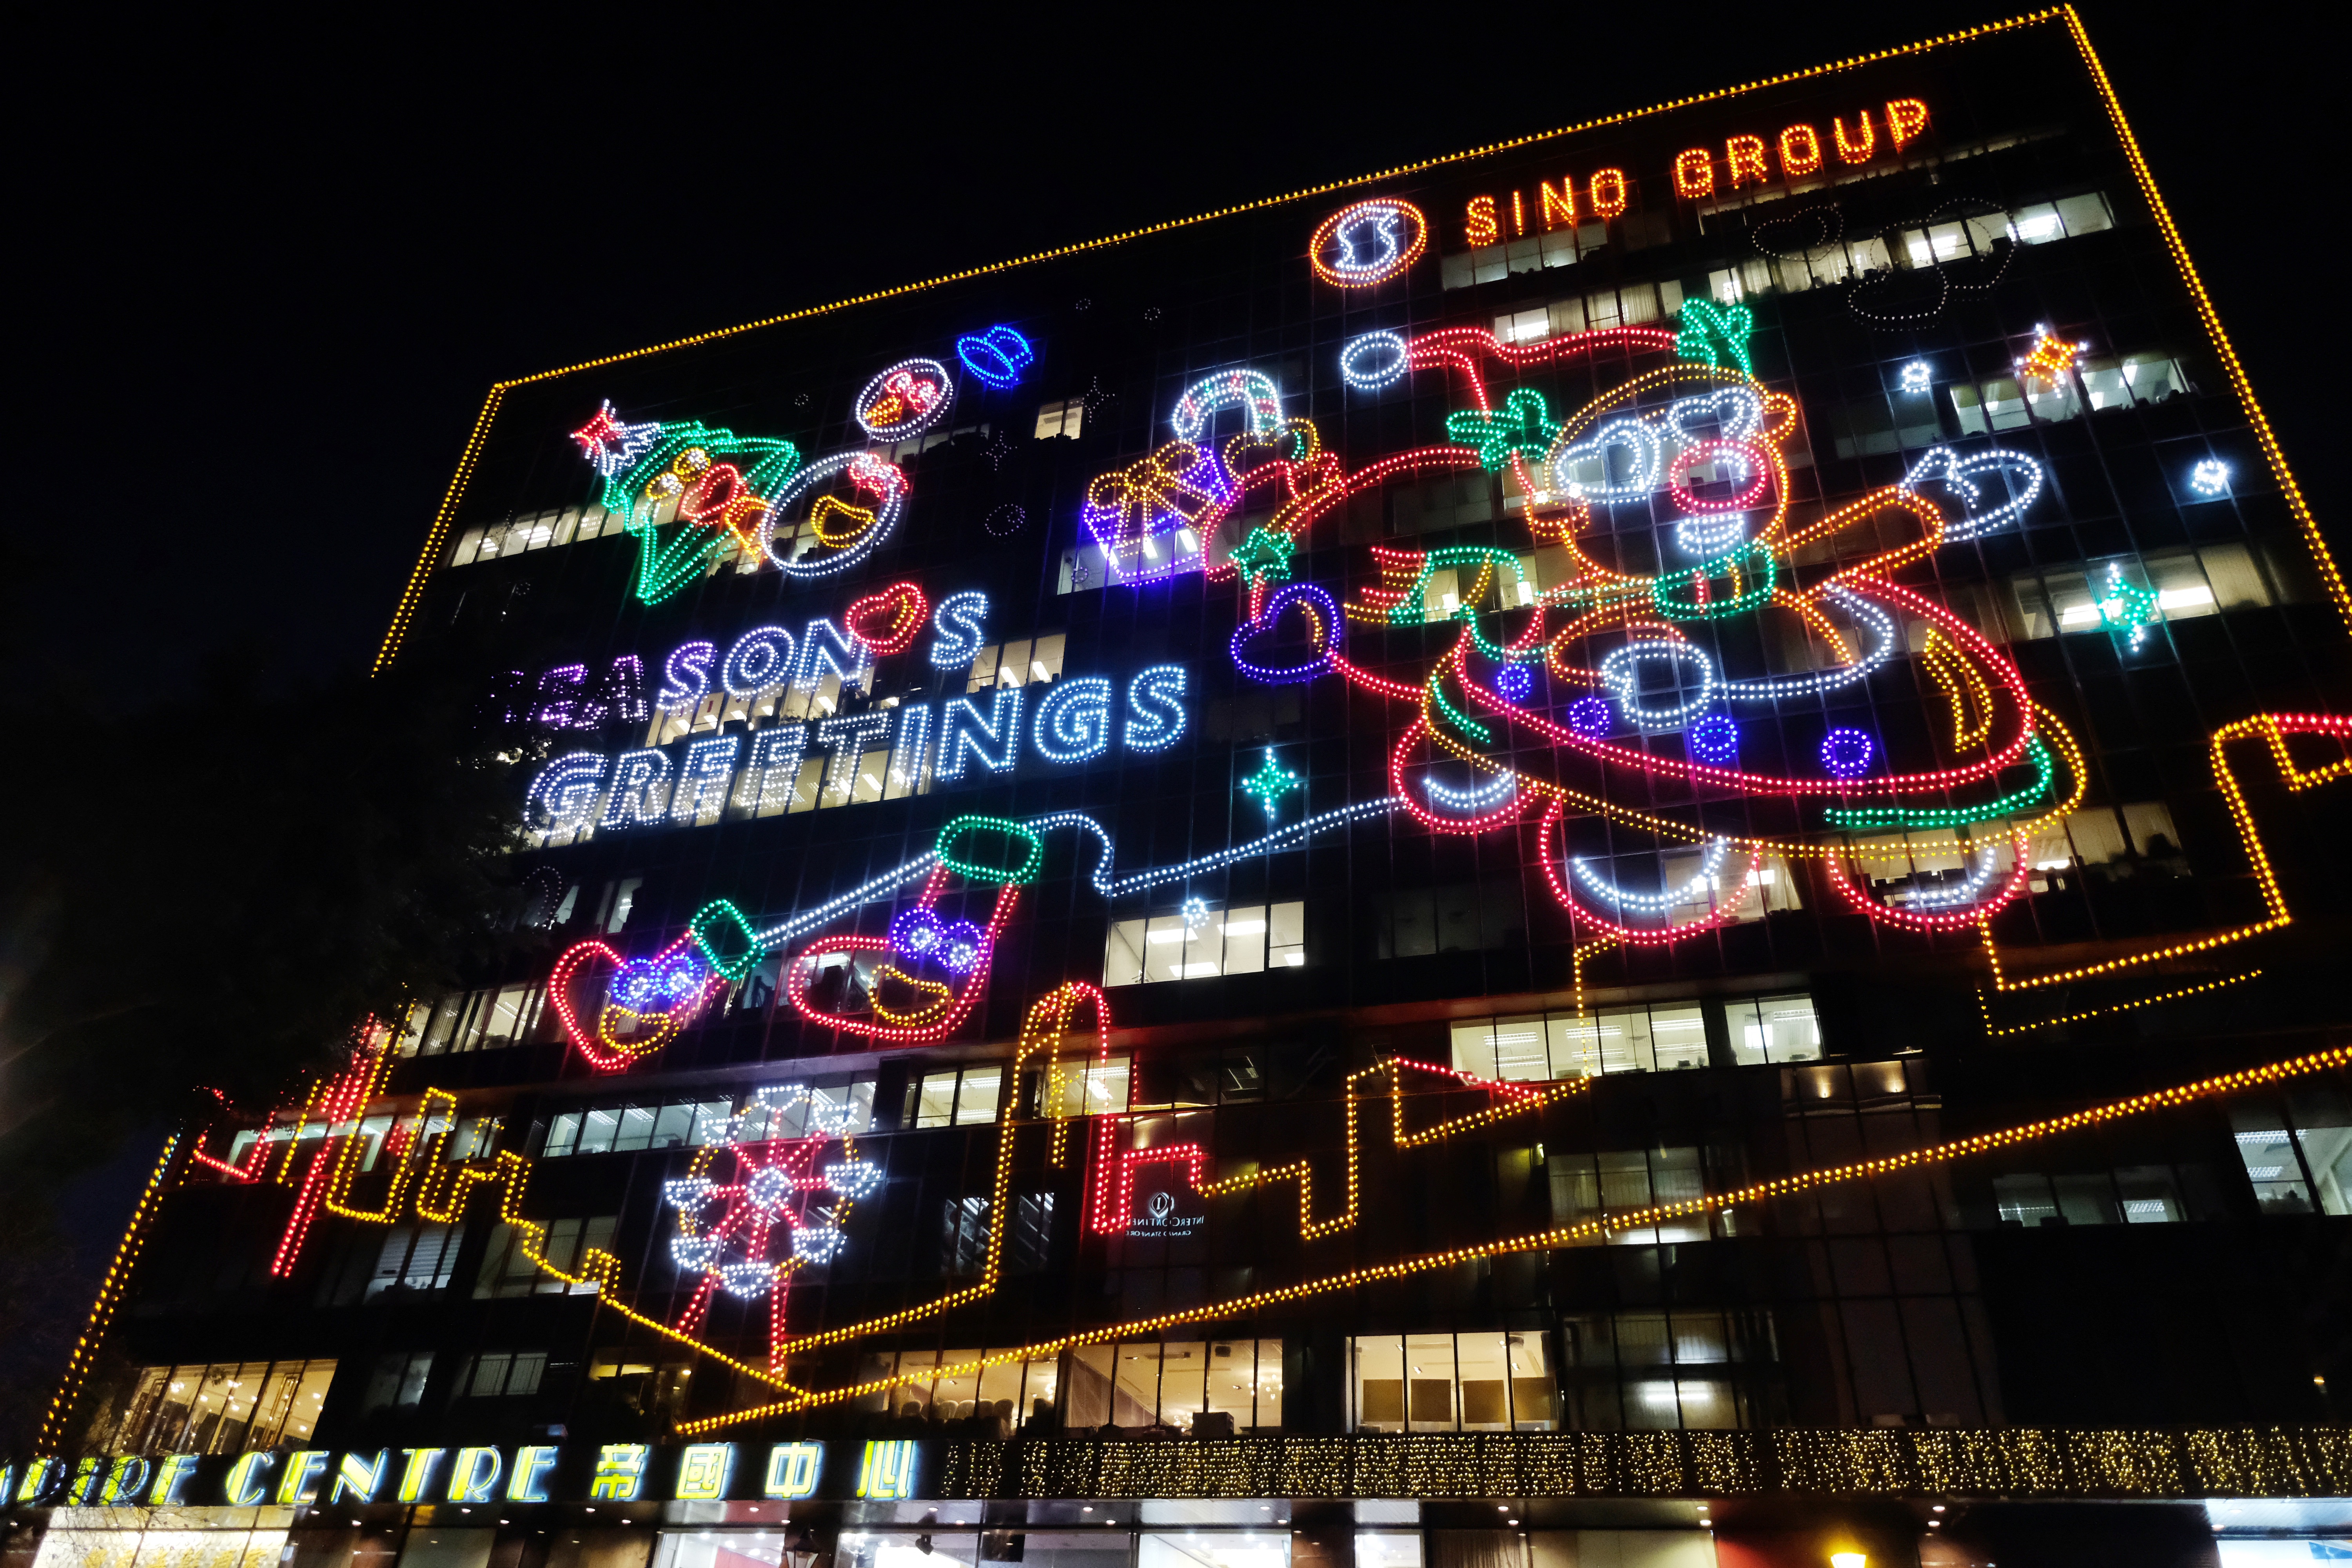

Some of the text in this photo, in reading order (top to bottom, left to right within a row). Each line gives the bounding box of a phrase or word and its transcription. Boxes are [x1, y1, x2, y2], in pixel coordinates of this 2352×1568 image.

[1467, 168, 1626, 245] SINO
[1675, 98, 1928, 198] GROUP
[524, 665, 1187, 838] GREETINGS
[225, 1444, 558, 1505] CENTRE
[590, 1439, 914, 1501] 帝國中心
